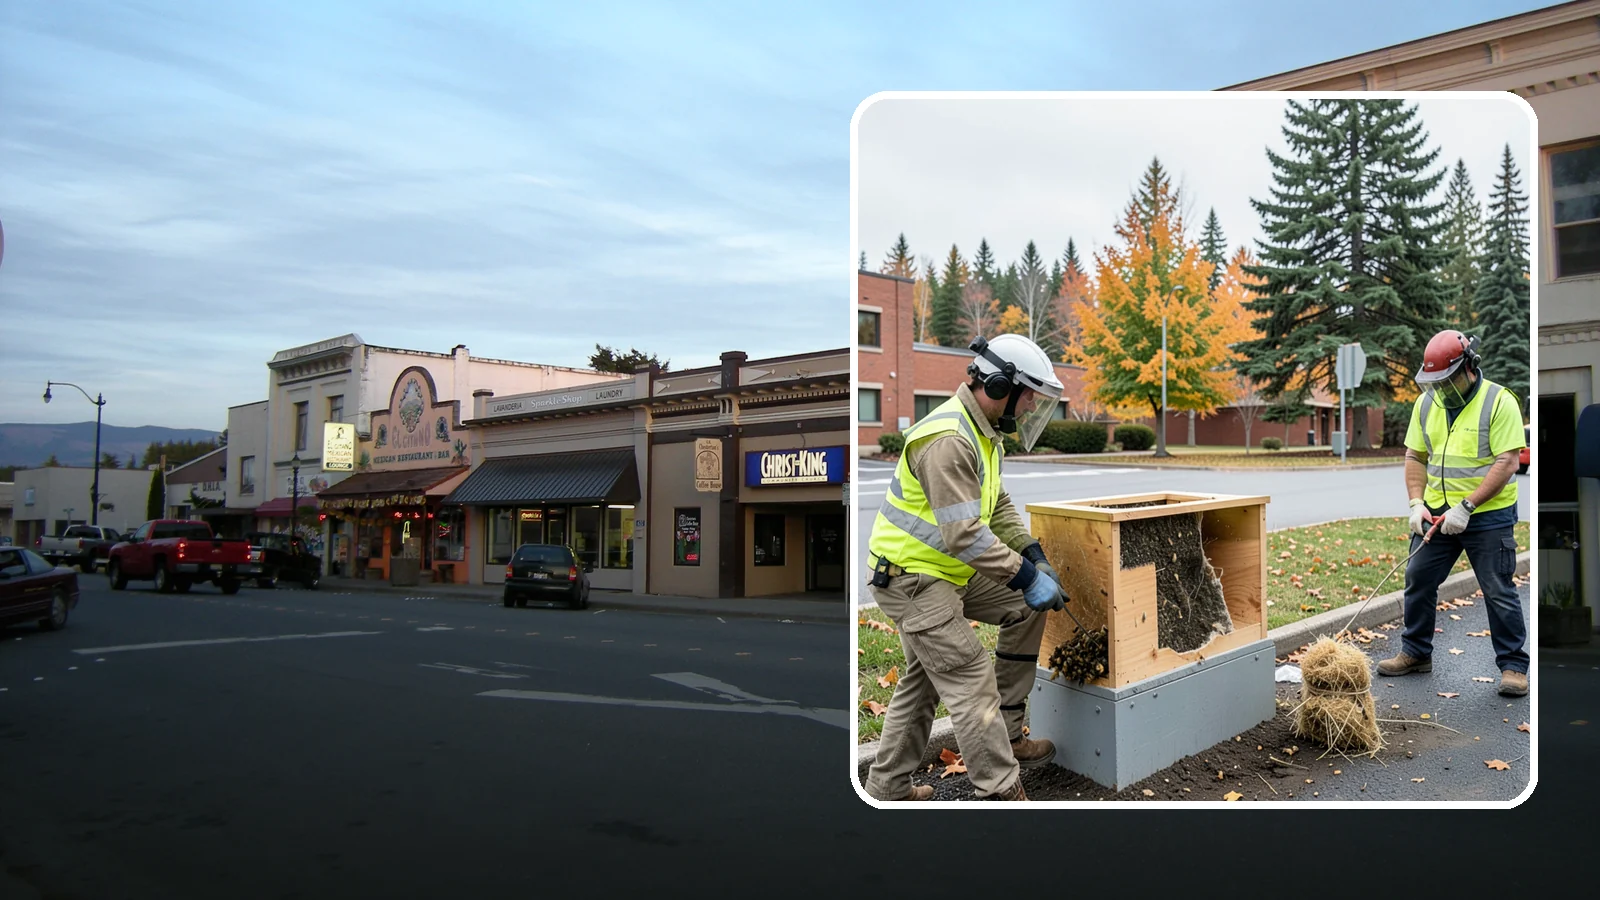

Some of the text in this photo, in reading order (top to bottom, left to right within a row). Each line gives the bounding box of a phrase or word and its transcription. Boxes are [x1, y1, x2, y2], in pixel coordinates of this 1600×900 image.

[530, 394, 583, 408] Sparkle Shop
[595, 389, 623, 400] LAUNDRY
[493, 402, 523, 412] LAVANDERIA
[373, 454, 396, 464] MEXICAN
[397, 451, 433, 462] RESTAURANT
[438, 450, 450, 459] BAR
[761, 450, 827, 478] CHRIST KING
